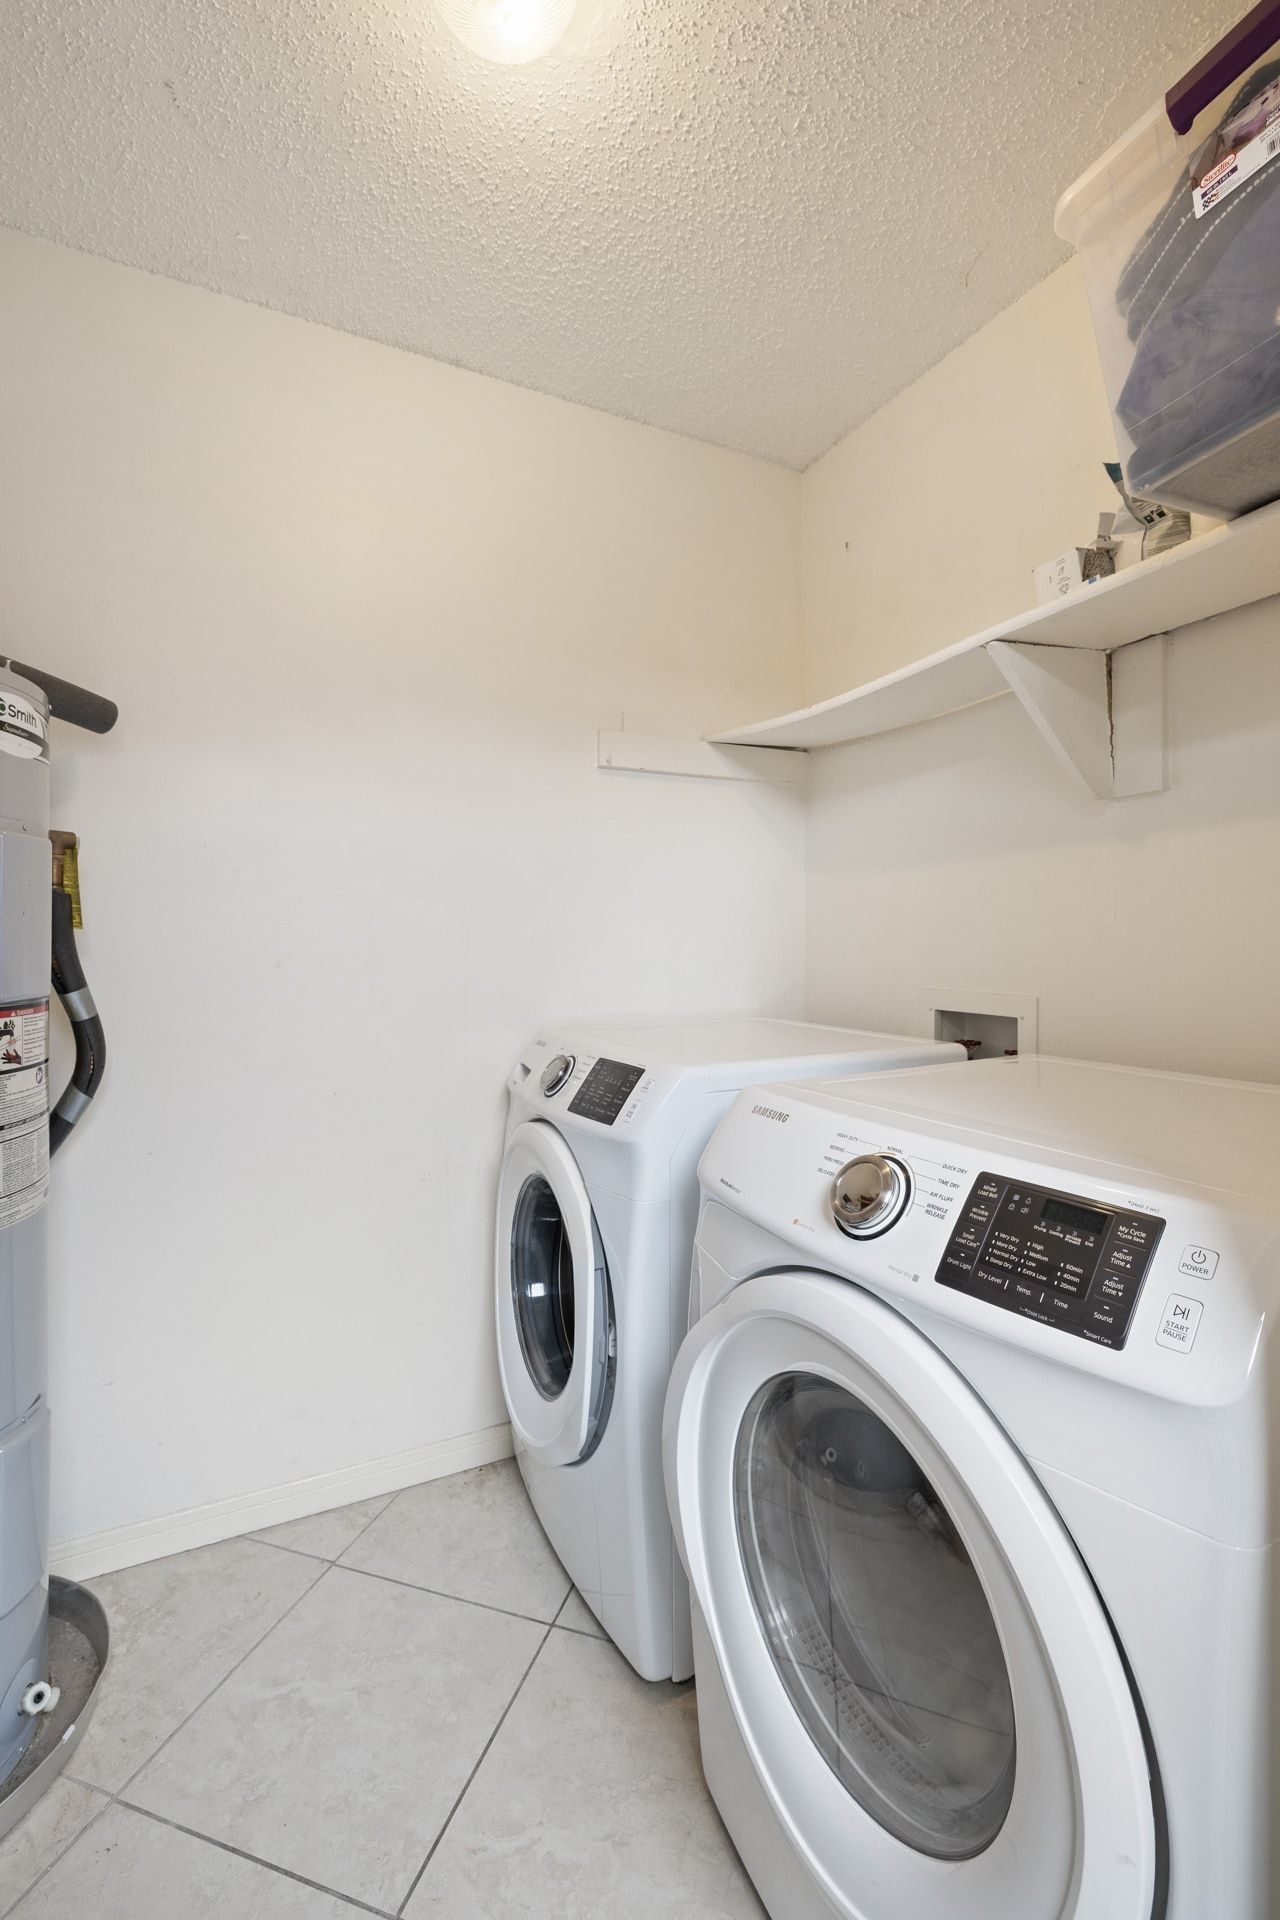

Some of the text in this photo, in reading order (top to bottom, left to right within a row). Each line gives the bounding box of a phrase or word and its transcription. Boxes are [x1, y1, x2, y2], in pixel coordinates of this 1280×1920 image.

[8, 704, 37, 728] Smith
[752, 1104, 790, 1123] SAMSUNG
[942, 1162, 968, 1175] QUICK DRY
[937, 1178, 961, 1190] TIME DRY
[939, 1194, 954, 1202] FLUFF
[926, 1202, 949, 1214] WRINKLE
[972, 1207, 989, 1217] Wrinkle
[924, 1208, 946, 1220] RELEASE
[969, 1212, 987, 1222] Prevent
[1033, 1224, 1047, 1233] Drying
[1119, 1225, 1147, 1238] My Cycle
[962, 1232, 975, 1240] Small
[1010, 1235, 1020, 1243] Dry
[1008, 1244, 1018, 1252] Dry
[1032, 1242, 1044, 1251] High
[993, 1249, 1019, 1262] Normal Dry
[1029, 1251, 1049, 1262] Medium
[1113, 1251, 1133, 1262] Adjust
[947, 1257, 971, 1271] Drum Light
[990, 1257, 1013, 1269] Damp Dry
[1066, 1263, 1084, 1274] 60min
[1111, 1258, 1125, 1268] Time
[1182, 1262, 1209, 1275] POWER
[978, 1270, 1003, 1284] Dry Level
[1022, 1268, 1036, 1277] Extra
[1063, 1272, 1080, 1283] 40min
[1016, 1285, 1032, 1296] Temp.
[1060, 1282, 1077, 1292] 20min
[1101, 1286, 1116, 1295] Time
[1104, 1279, 1124, 1291] Adjust
[1054, 1299, 1068, 1310] Time
[1038, 1313, 1048, 1321] Lock
[1093, 1311, 1113, 1324] Sound
[1166, 1320, 1190, 1333] START
[1101, 1336, 1112, 1345] Care
[1162, 1328, 1187, 1342] PAUSE
